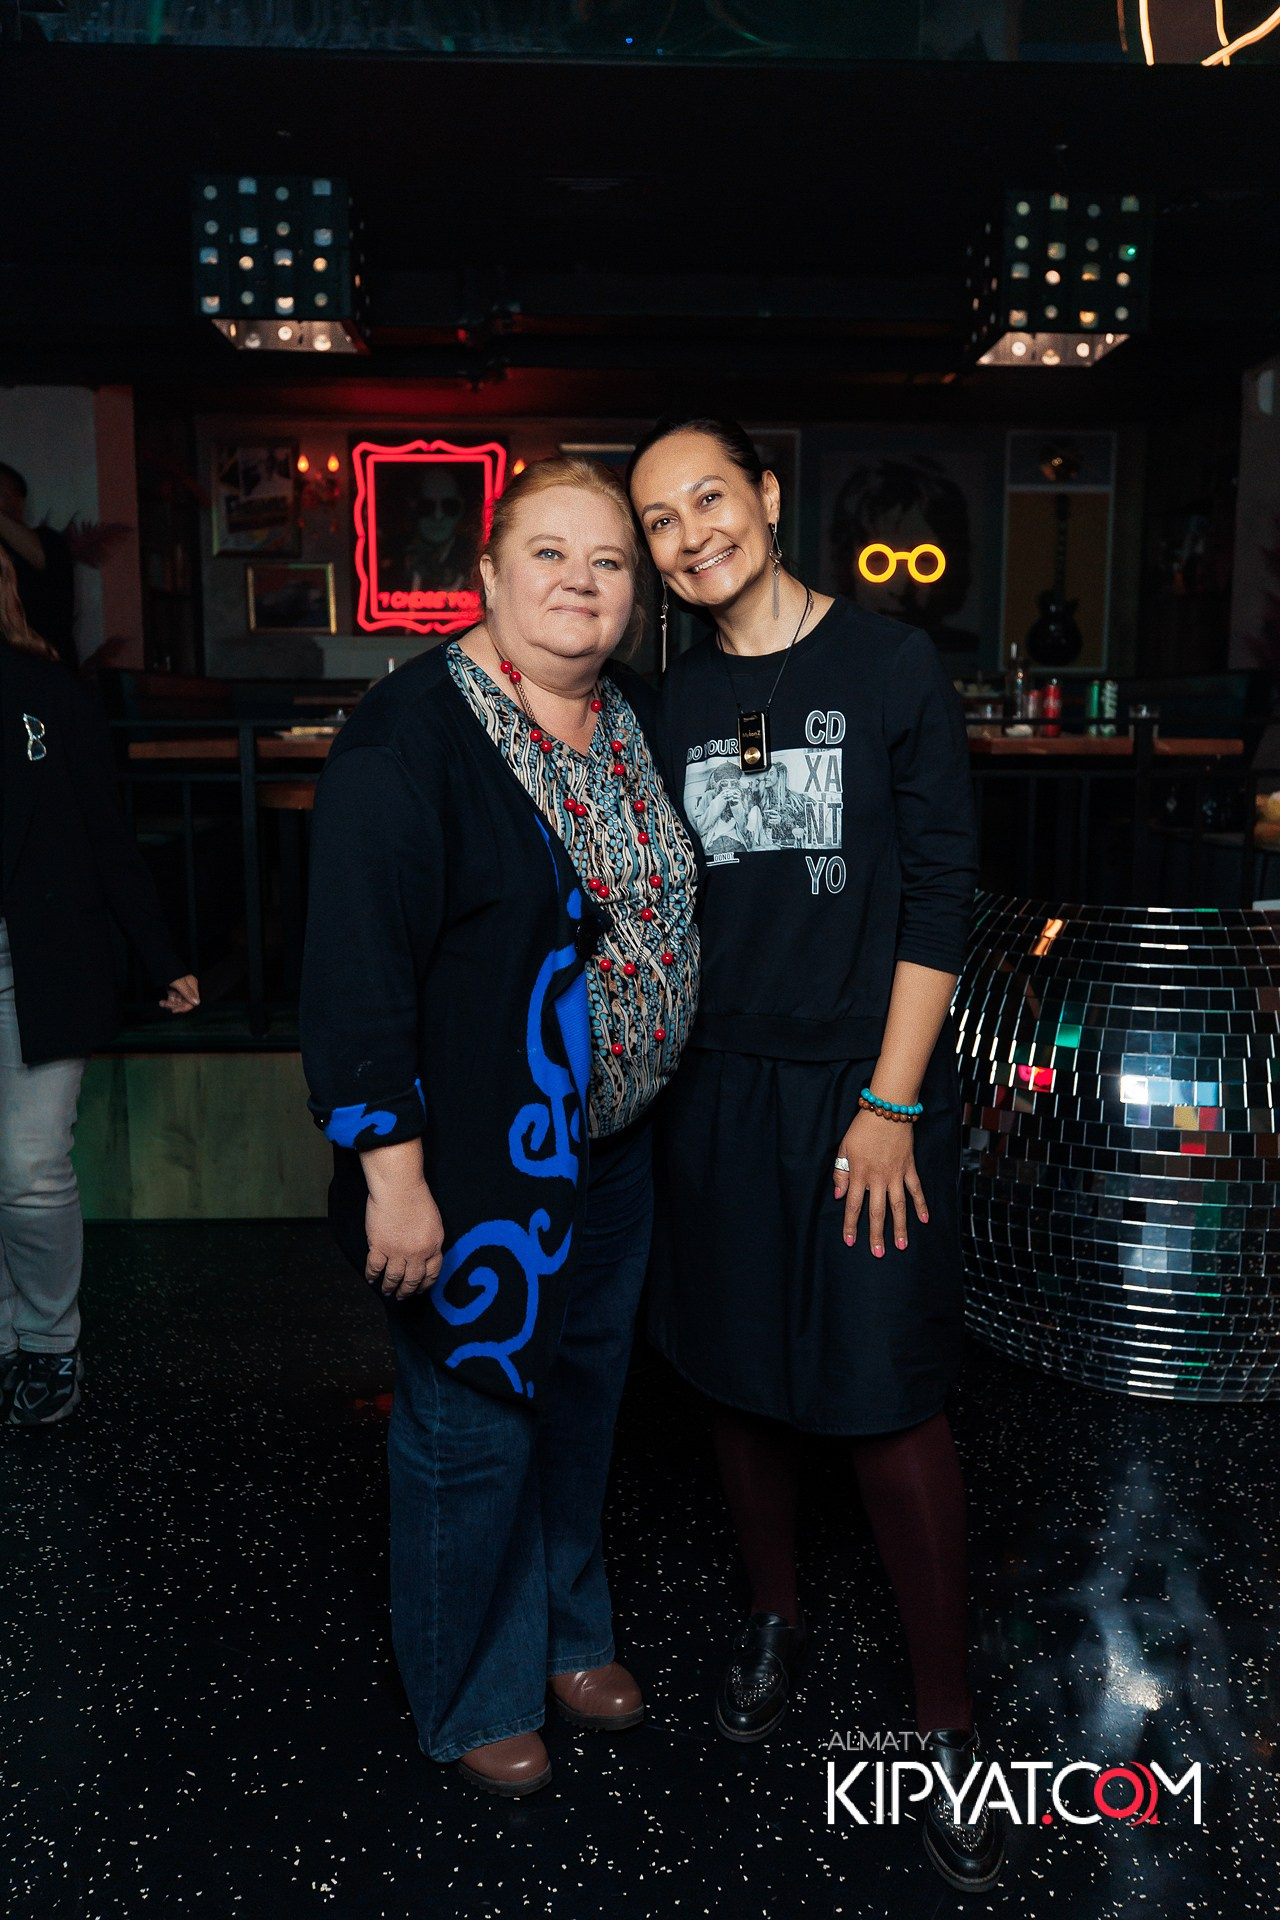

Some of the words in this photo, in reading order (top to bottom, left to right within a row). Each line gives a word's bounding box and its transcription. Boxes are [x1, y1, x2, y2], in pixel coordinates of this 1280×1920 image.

[805, 710, 846, 744] CD
[687, 745, 703, 763] DO
[804, 753, 844, 794] XA
[804, 802, 843, 846] NT
[805, 856, 847, 895] YO
